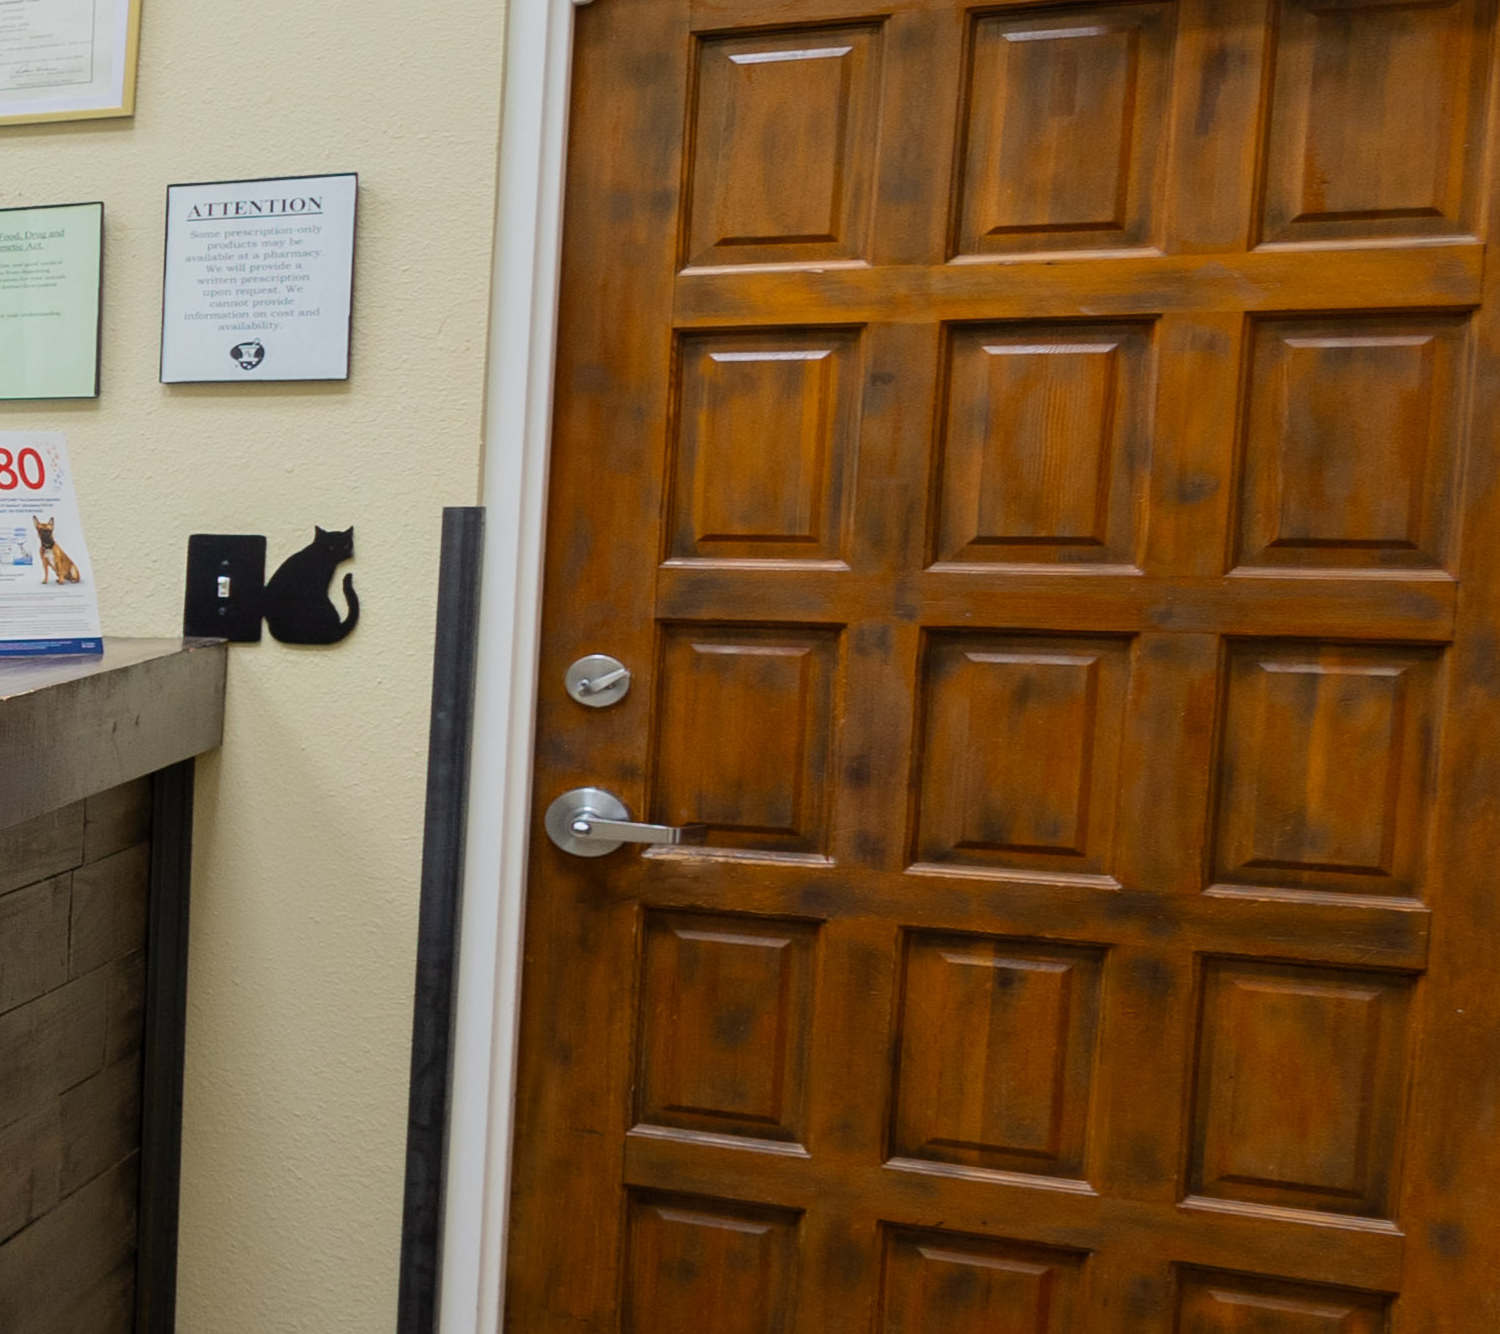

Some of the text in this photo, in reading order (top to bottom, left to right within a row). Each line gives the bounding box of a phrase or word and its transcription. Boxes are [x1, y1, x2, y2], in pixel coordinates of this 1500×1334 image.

[188, 197, 322, 217] ATTENTION
[25, 230, 46, 240] Drug
[50, 228, 65, 238] and
[190, 225, 323, 239] Some prescription-only
[207, 237, 303, 251] products may be
[185, 251, 234, 263] available
[263, 250, 324, 261] pharmacy.
[206, 265, 222, 273] We
[226, 263, 245, 272] will
[250, 262, 291, 274] provide
[198, 273, 310, 286] written prescription
[203, 285, 303, 298] upon request. We
[210, 298, 294, 309] cannot provide
[184, 311, 250, 320] information
[271, 309, 294, 317] cost
[298, 308, 320, 316] and
[218, 320, 283, 331] availability.
